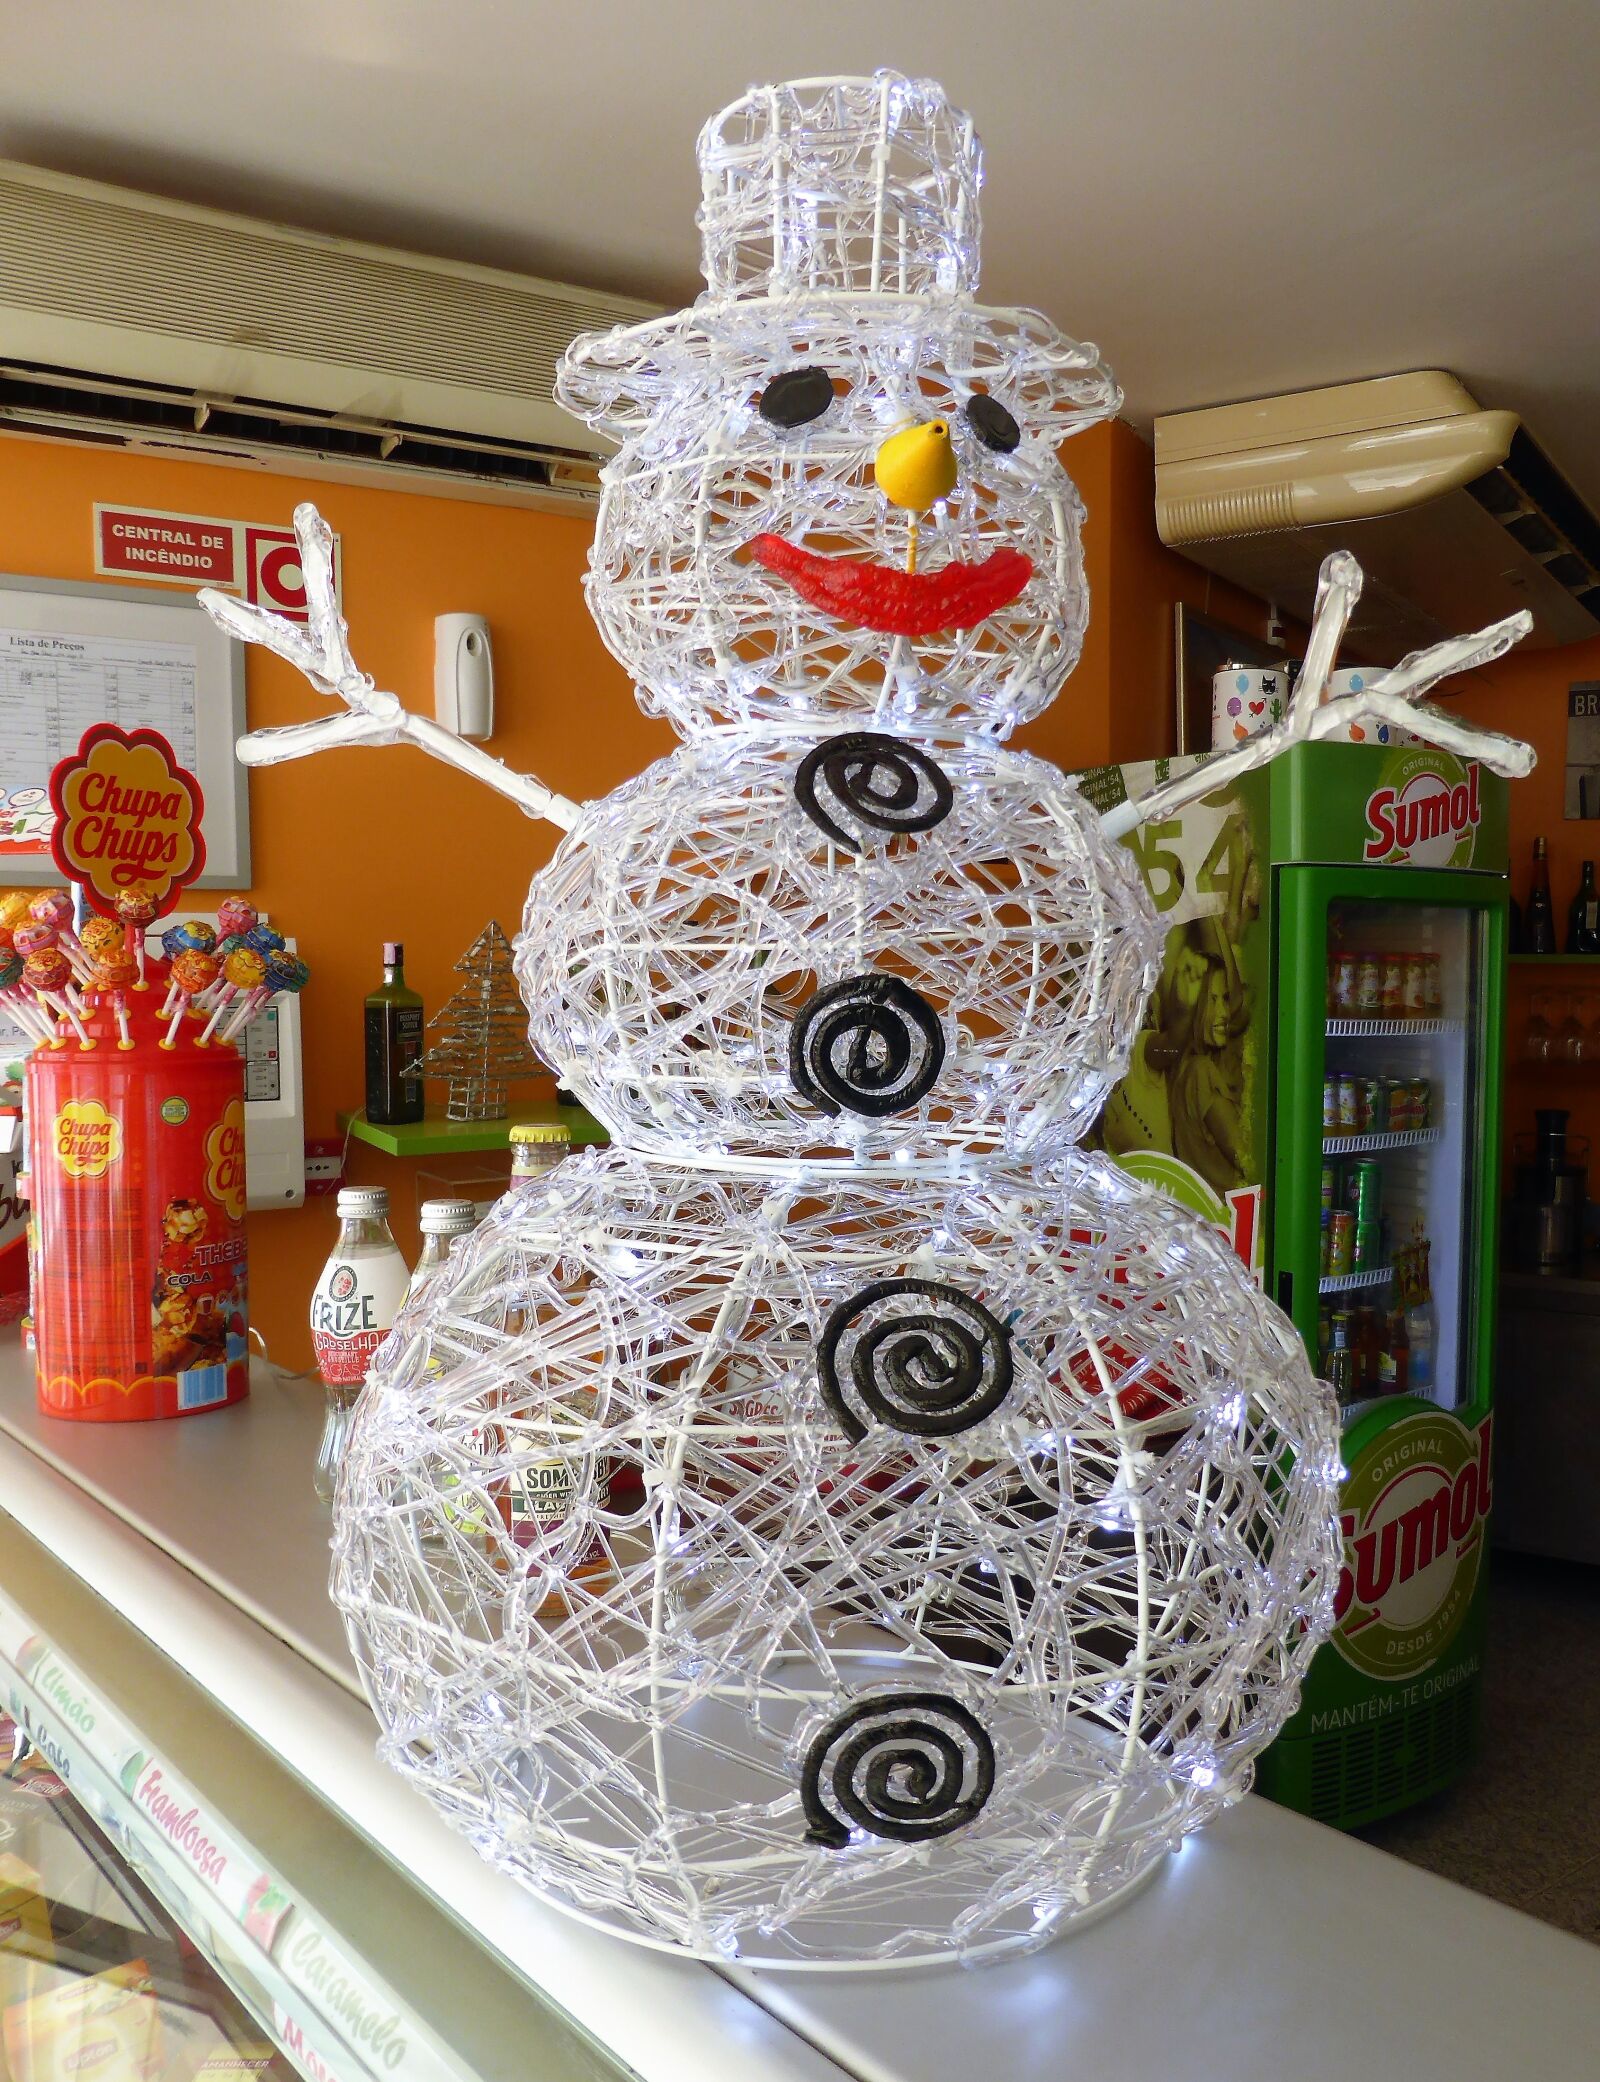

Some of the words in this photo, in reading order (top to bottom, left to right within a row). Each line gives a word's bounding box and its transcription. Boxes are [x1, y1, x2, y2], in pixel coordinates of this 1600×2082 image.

[112, 524, 196, 546] CENTRAL
[201, 535, 224, 550] DE
[125, 546, 213, 569] INCÊNDIO
[10, 636, 35, 648] Lista
[38, 640, 50, 648] de
[1402, 757, 1445, 776] ORIGINAL
[79, 772, 183, 829] Chupa
[1364, 762, 1480, 861] Sumol
[74, 815, 179, 885] Chups
[60, 1118, 113, 1141] Chupa
[58, 1137, 110, 1166] Chups
[168, 1271, 213, 1286] COLA
[312, 1293, 378, 1338] FRIZE
[316, 1332, 380, 1351] GROSELHA
[1371, 1438, 1444, 1482] ORIGINAL
[1385, 1631, 1434, 1656] DESDE
[1423, 1655, 1481, 1699] ORIGINAL
[140, 1769, 230, 1886] Framboesa
[291, 1931, 408, 2071] Caramelo
